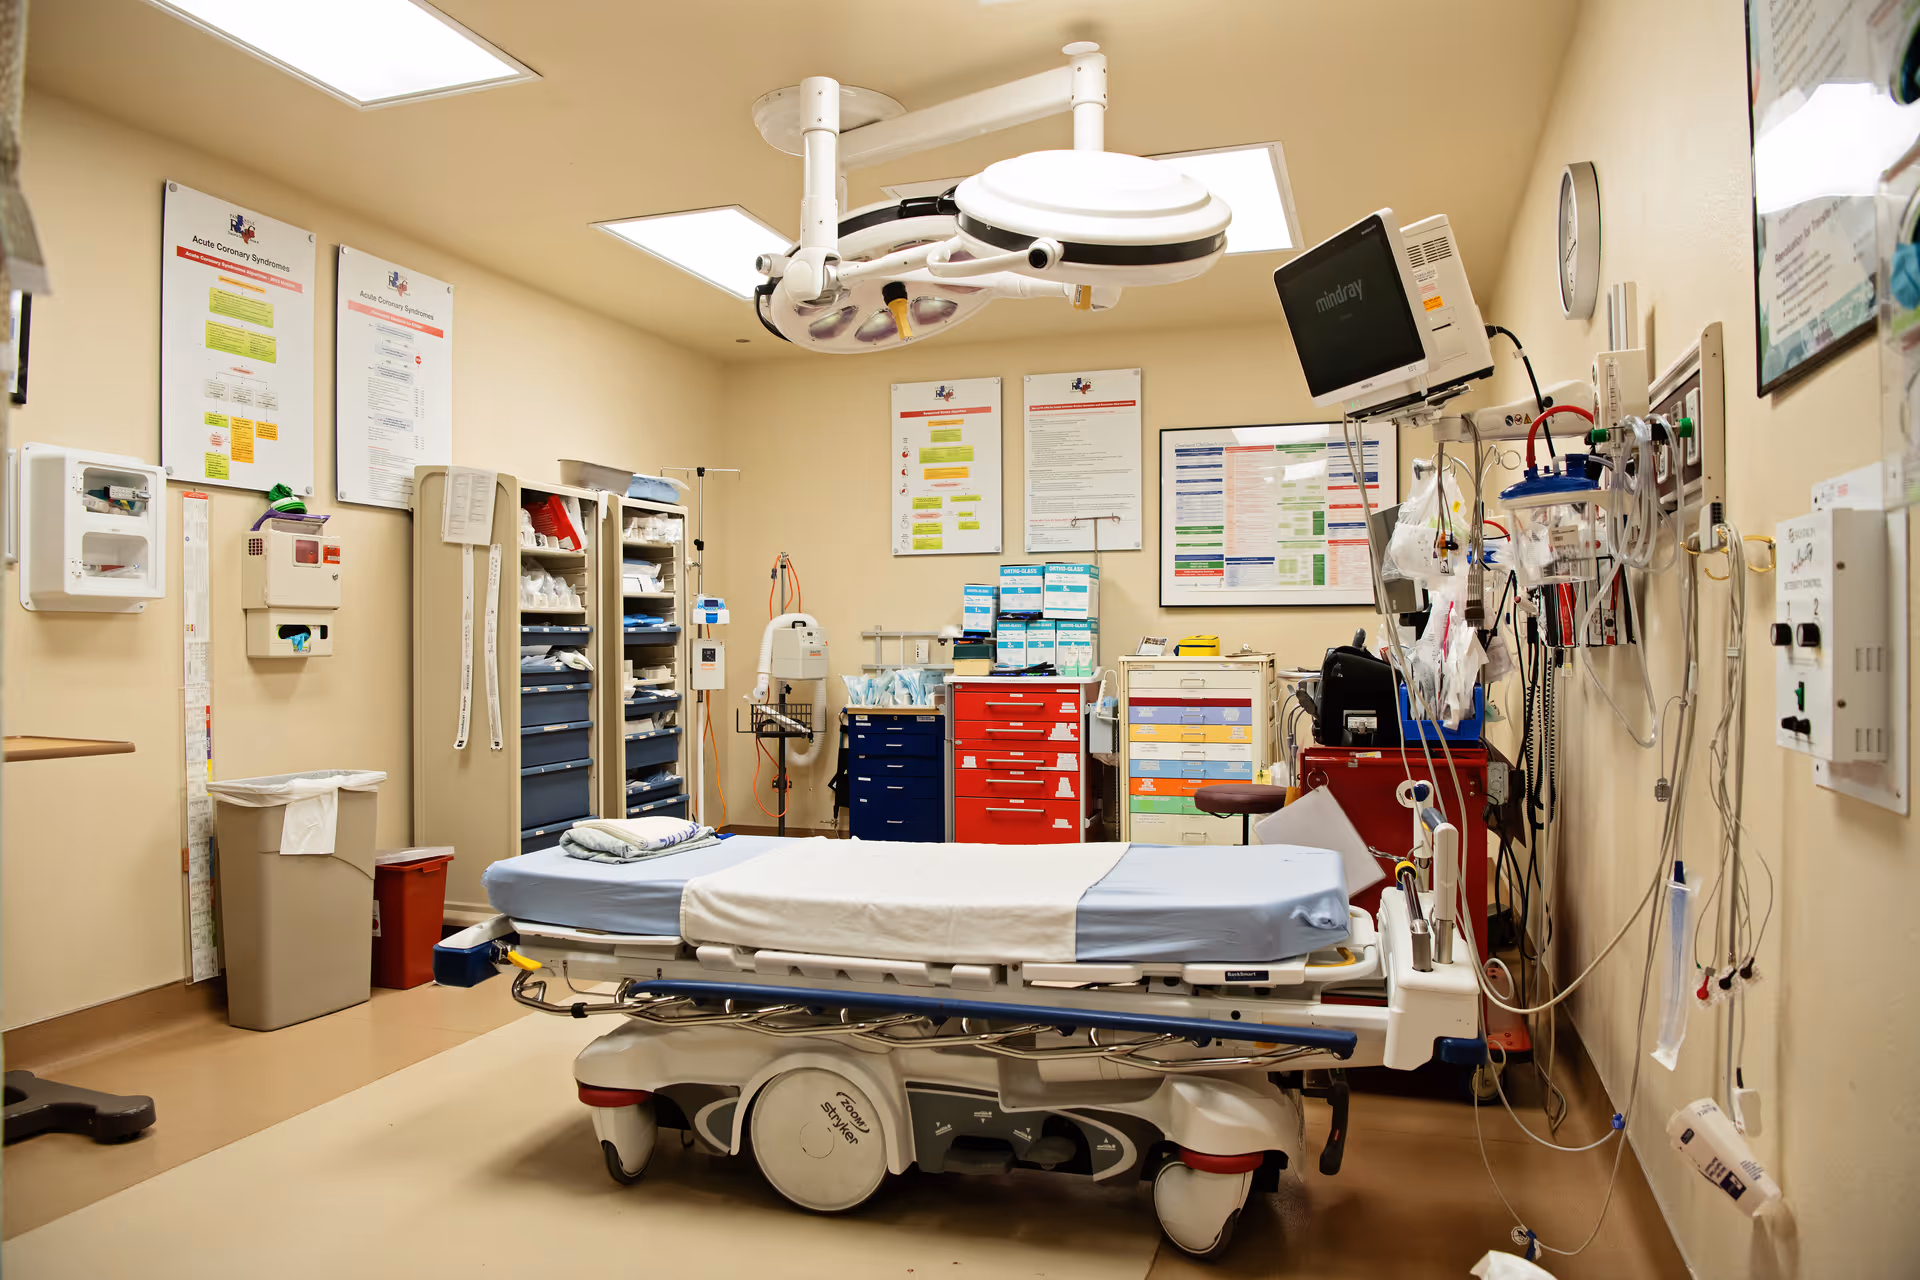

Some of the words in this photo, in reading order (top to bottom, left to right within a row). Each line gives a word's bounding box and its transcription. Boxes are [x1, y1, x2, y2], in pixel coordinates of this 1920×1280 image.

[185, 251, 200, 260] Acute
[192, 235, 215, 249] Acute
[217, 242, 250, 261] Coronary
[251, 254, 290, 272] Syndromes
[360, 290, 377, 302] Acute
[378, 296, 404, 312] Coronary
[404, 305, 434, 320] Syndromes
[1315, 278, 1363, 313] mindray
[1814, 597, 1819, 616] 2
[820, 1101, 858, 1145] stryker
[840, 1098, 866, 1127] ZOOM
